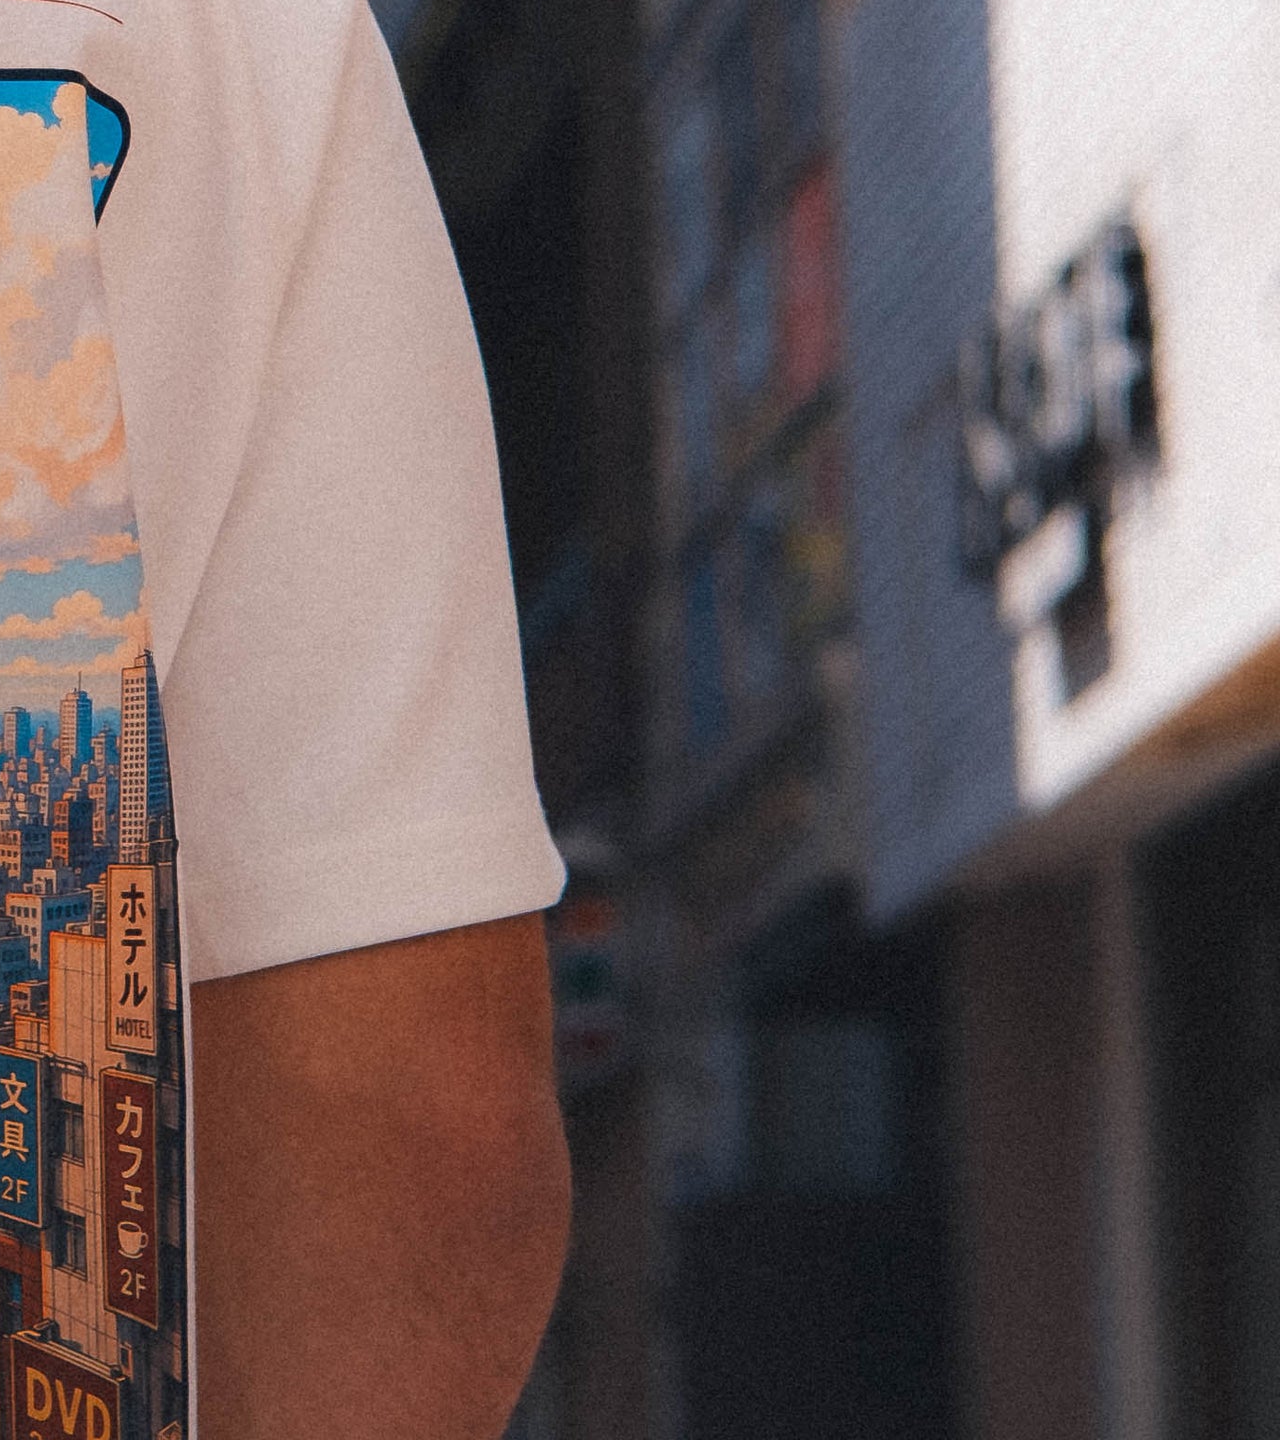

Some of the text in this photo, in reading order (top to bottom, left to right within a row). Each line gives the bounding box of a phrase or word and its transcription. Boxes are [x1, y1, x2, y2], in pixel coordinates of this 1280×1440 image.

[118, 882, 148, 1008] ホテル
[115, 1016, 153, 1041] HOTEL
[0, 1072, 29, 1162] 文具
[116, 1095, 144, 1212] カフェ
[1, 1175, 29, 1204] 2F
[120, 1268, 147, 1299] 2F
